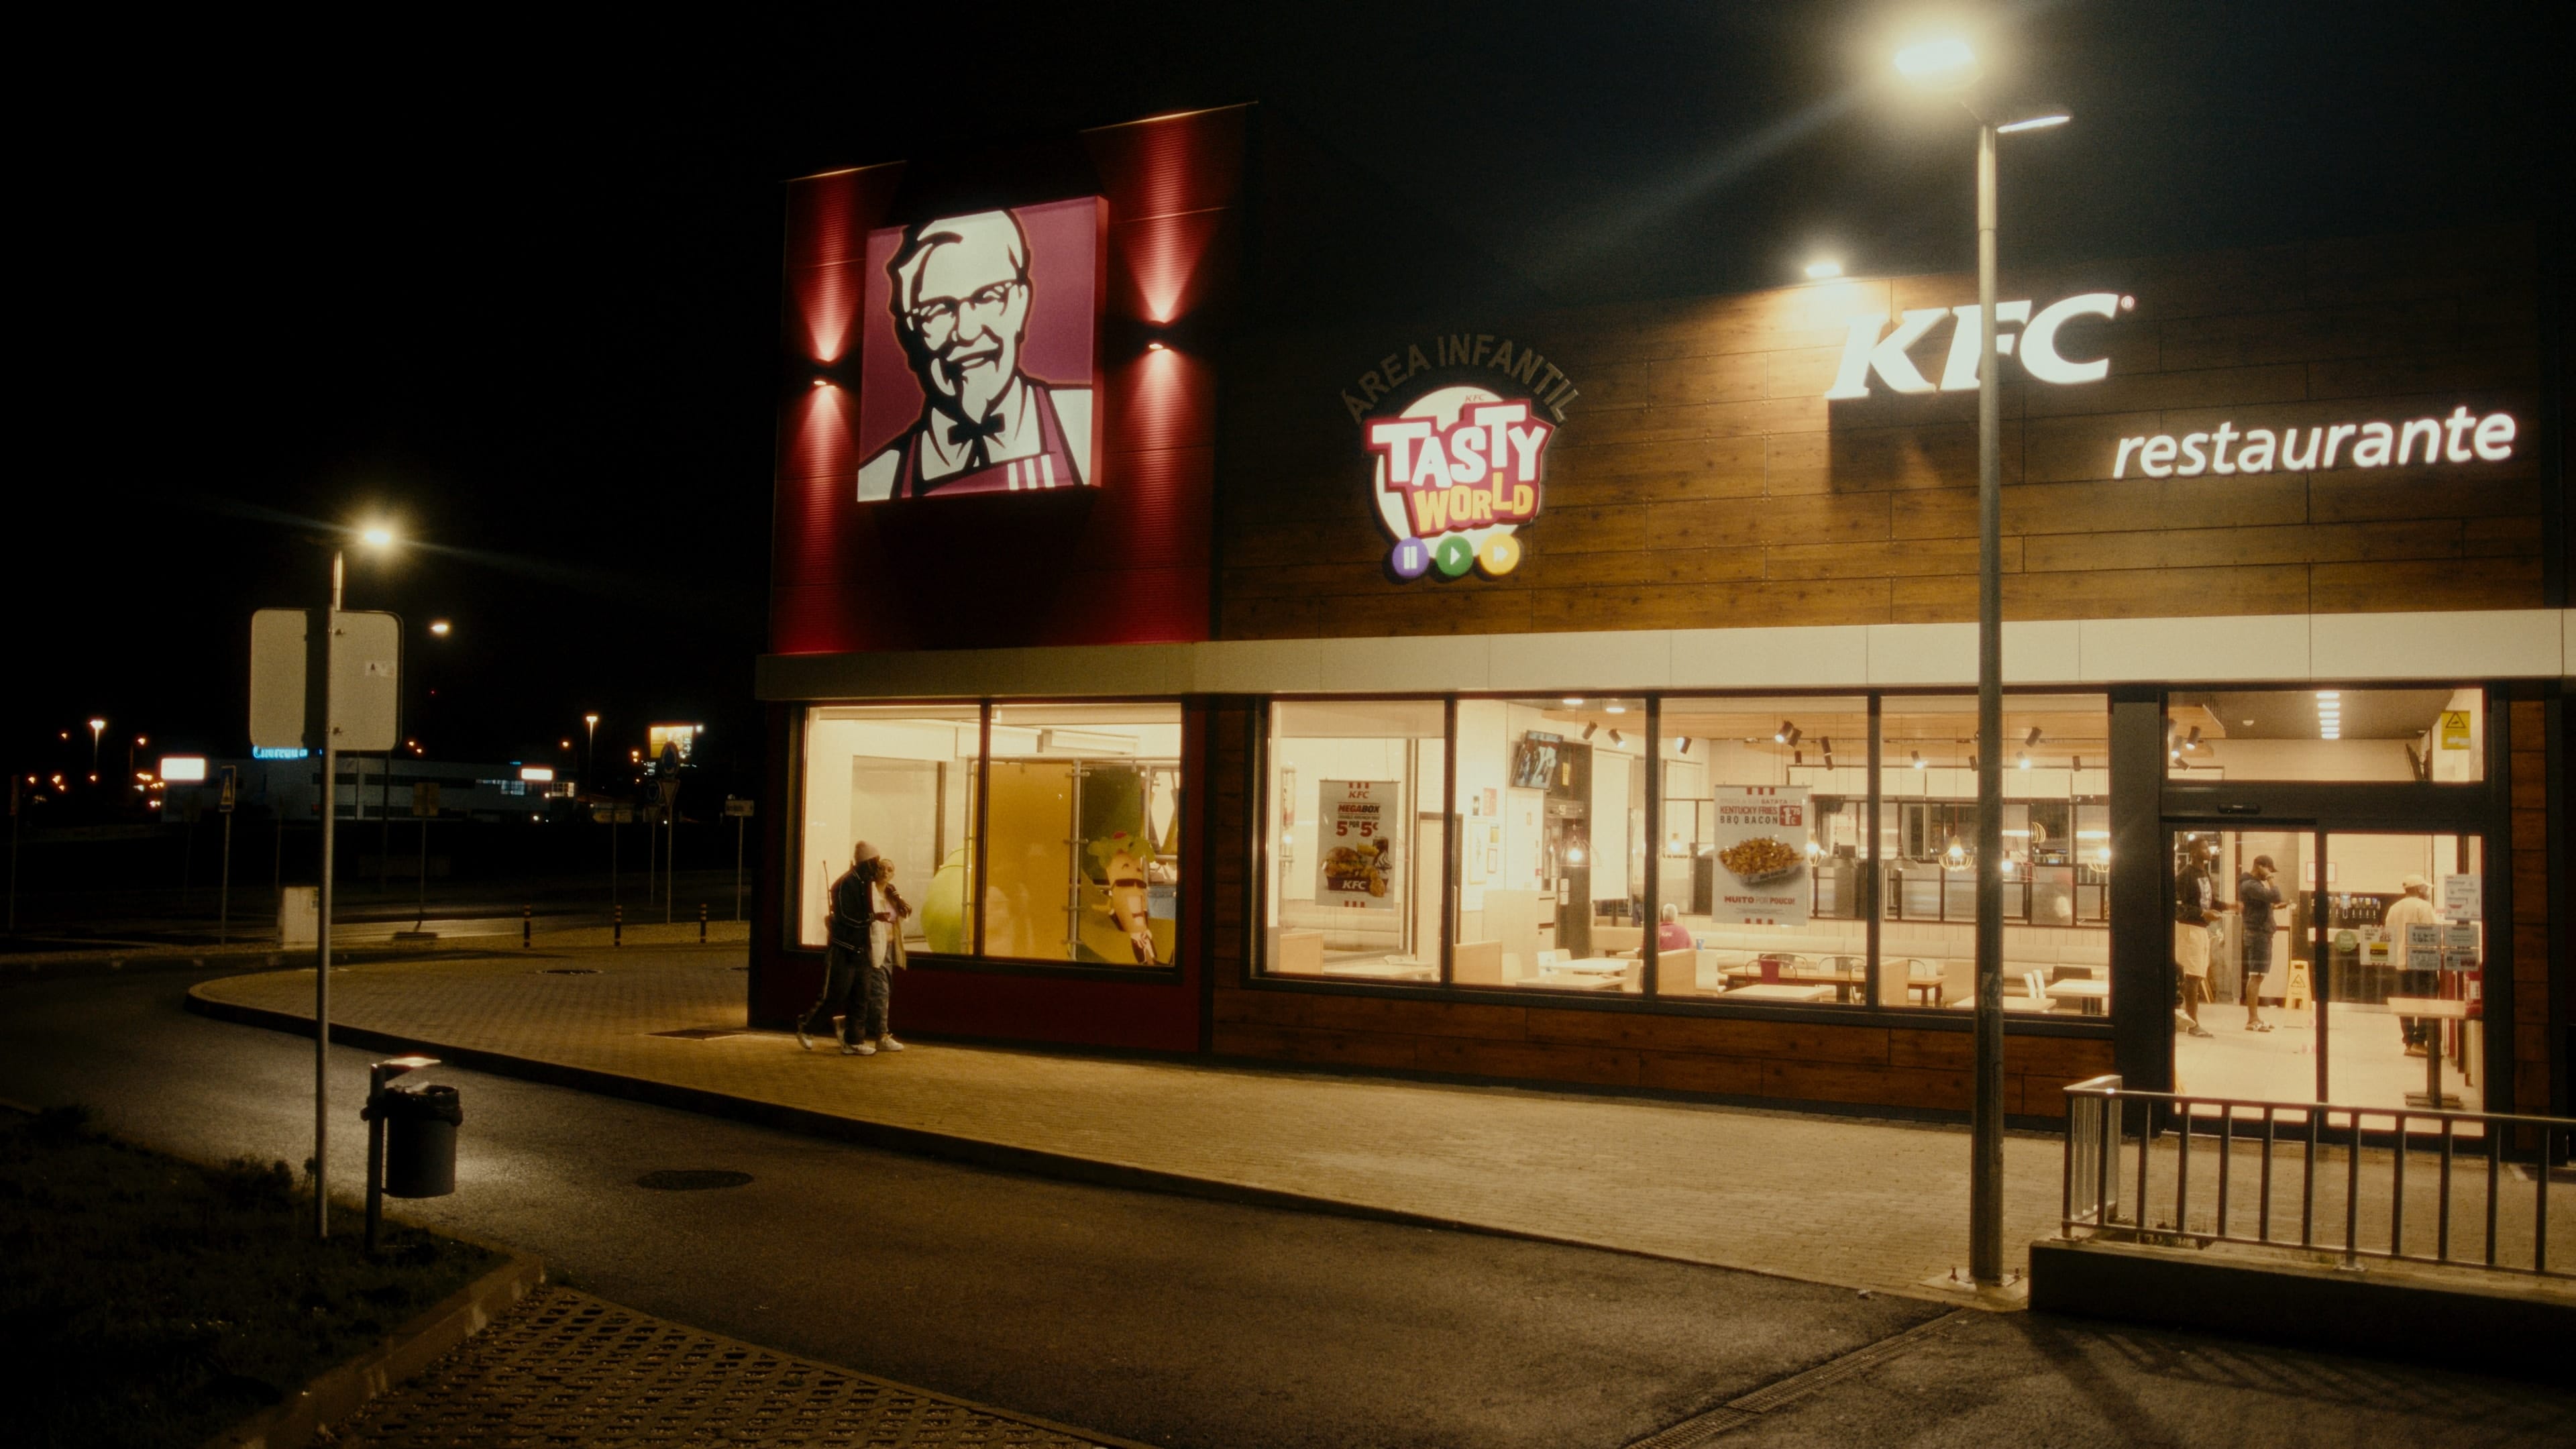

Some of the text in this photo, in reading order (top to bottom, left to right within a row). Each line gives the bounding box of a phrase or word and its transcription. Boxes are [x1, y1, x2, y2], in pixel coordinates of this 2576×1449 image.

[1438, 333, 1580, 423] INFANTIL
[1464, 394, 1486, 402] KFC
[1372, 404, 1547, 488] TASTY
[2112, 406, 2516, 479] restaurante
[1413, 472, 1534, 533] WORLD
[1720, 806, 1778, 816] KENTUCKY FRIES
[1720, 816, 1778, 824] BBQ BACON
[1336, 820, 1348, 837] 5
[1342, 880, 1366, 890] KFC
[1724, 896, 1754, 904] MUITO
